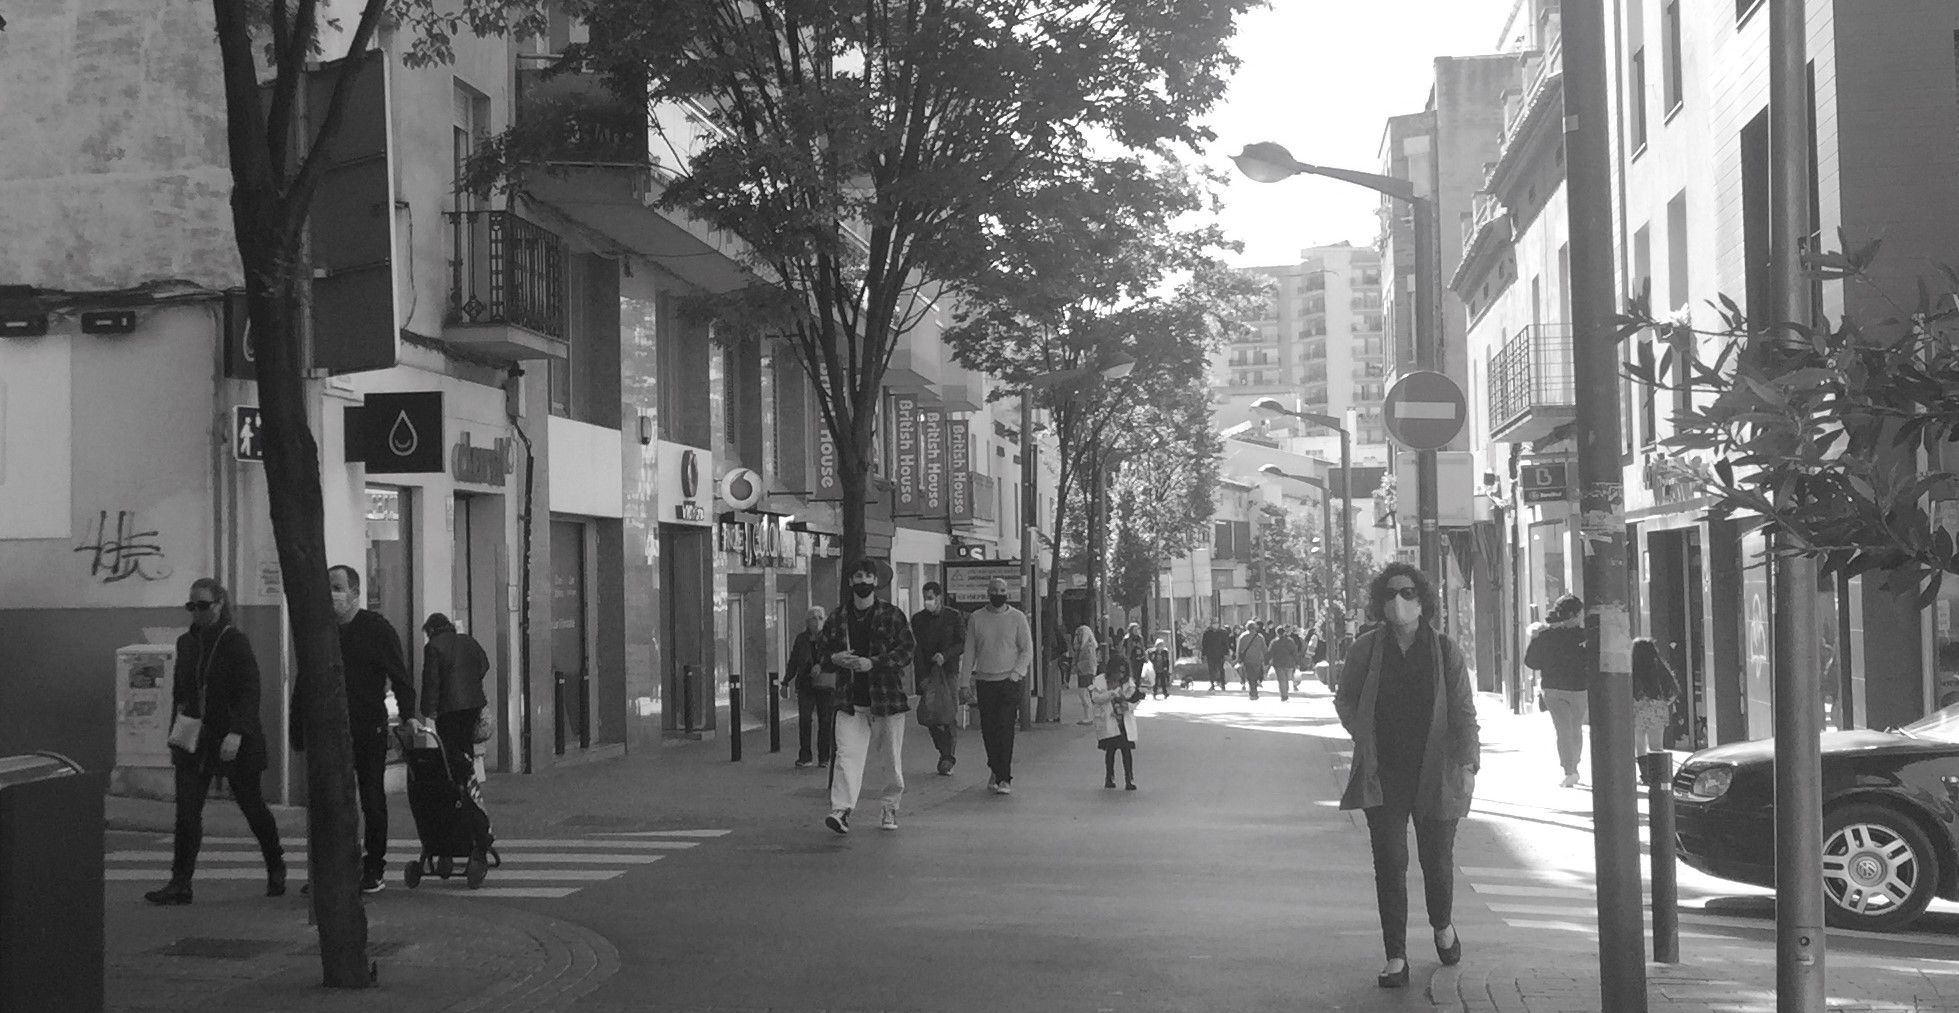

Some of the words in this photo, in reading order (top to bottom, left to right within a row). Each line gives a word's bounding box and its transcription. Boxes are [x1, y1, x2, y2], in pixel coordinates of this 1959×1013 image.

[900, 399, 914, 450] British
[926, 412, 941, 459] British
[952, 424, 966, 469] British
[900, 454, 914, 504] House
[927, 463, 941, 508] House
[952, 471, 967, 514] House
